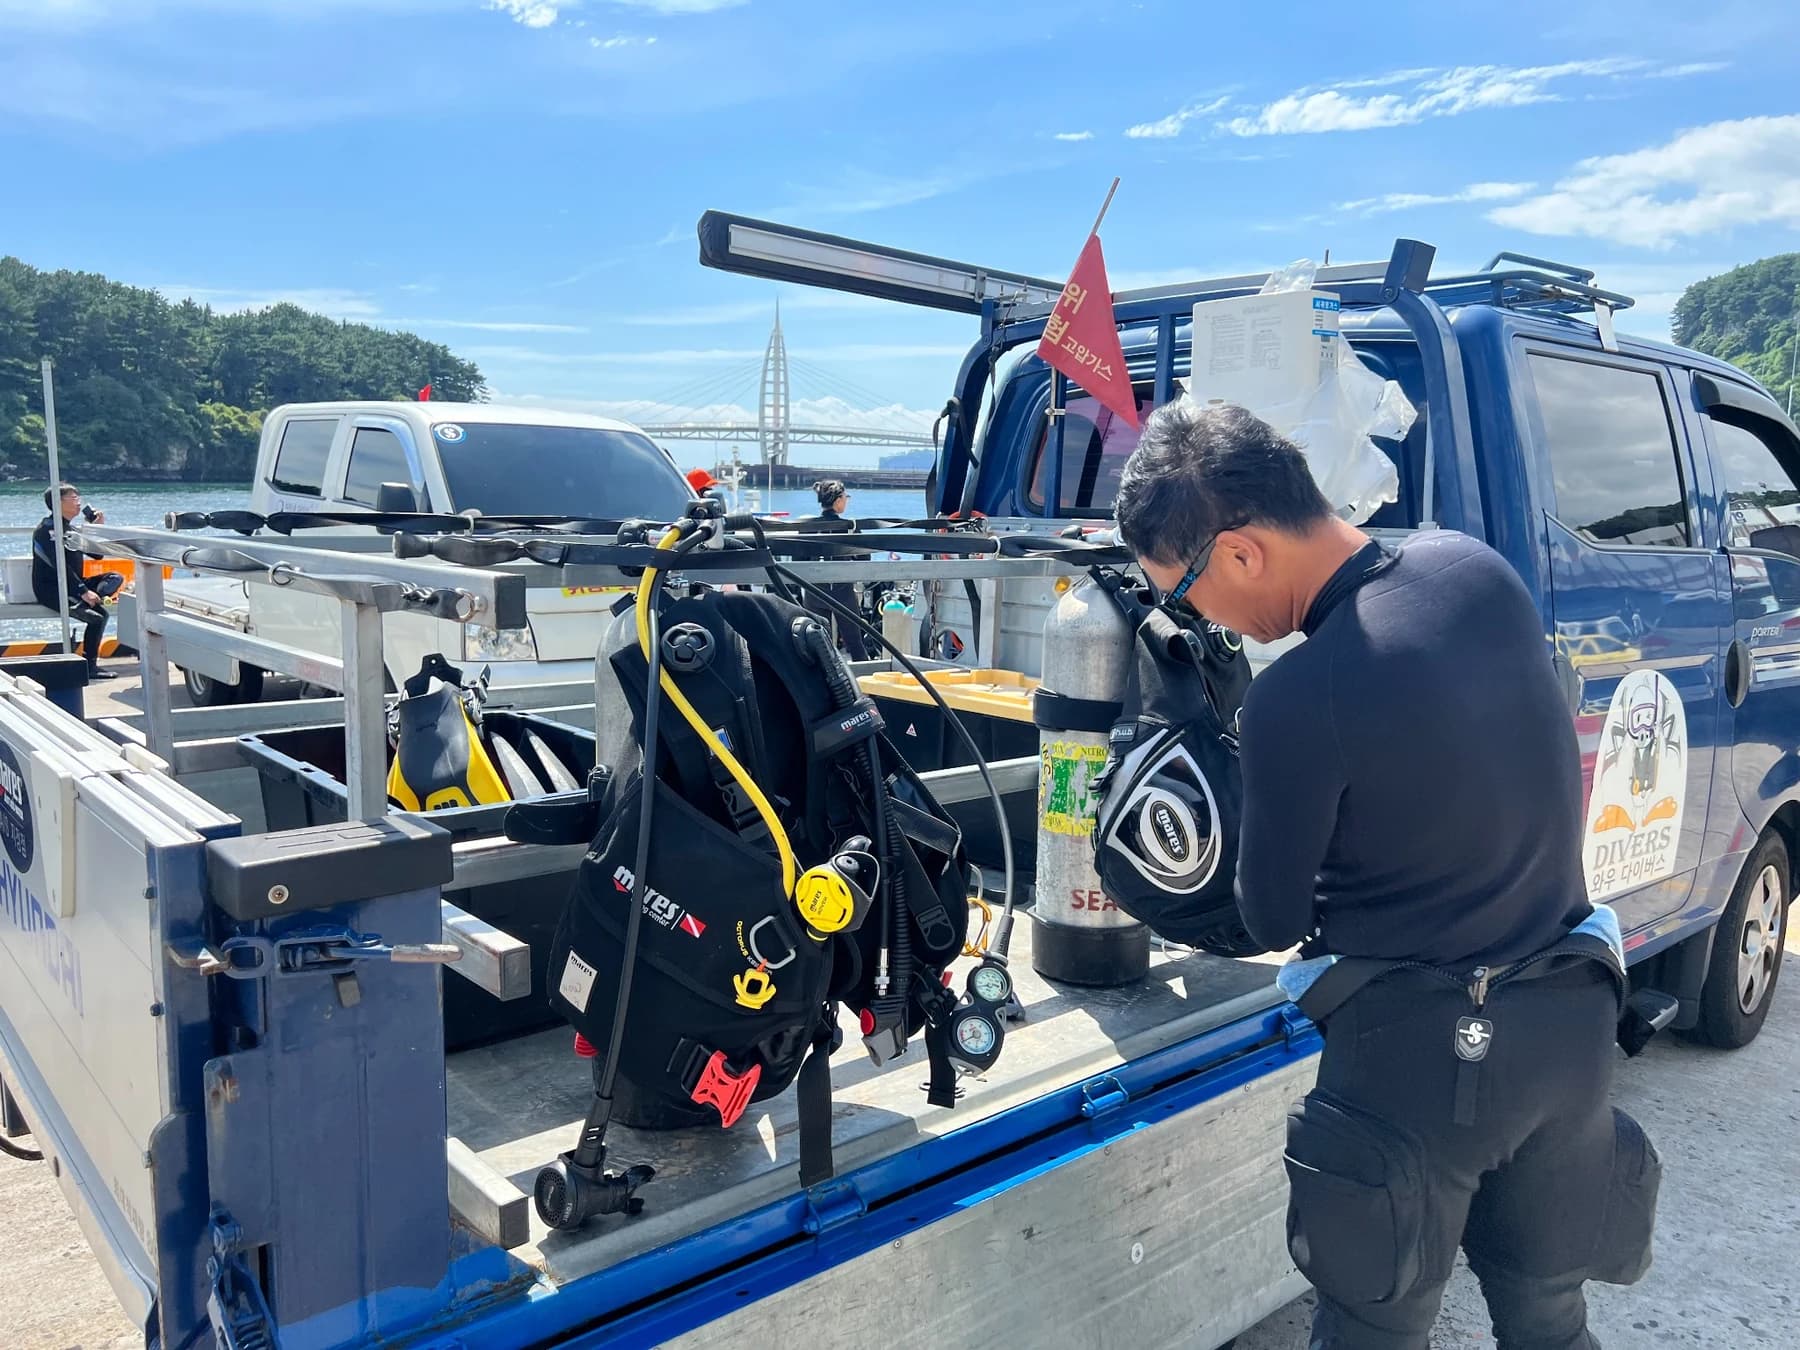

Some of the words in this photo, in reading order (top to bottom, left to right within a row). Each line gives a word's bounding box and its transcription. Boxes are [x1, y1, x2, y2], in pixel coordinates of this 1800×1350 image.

[1061, 335, 1113, 382] 고압가스
[840, 709, 870, 731] mares
[1156, 809, 1184, 854] mares
[1593, 826, 1671, 870] DIVERS
[613, 865, 680, 920] mres
[1590, 868, 1616, 893] 와우
[1621, 854, 1665, 884] 다이버스
[736, 920, 749, 957] OCTOPUS
